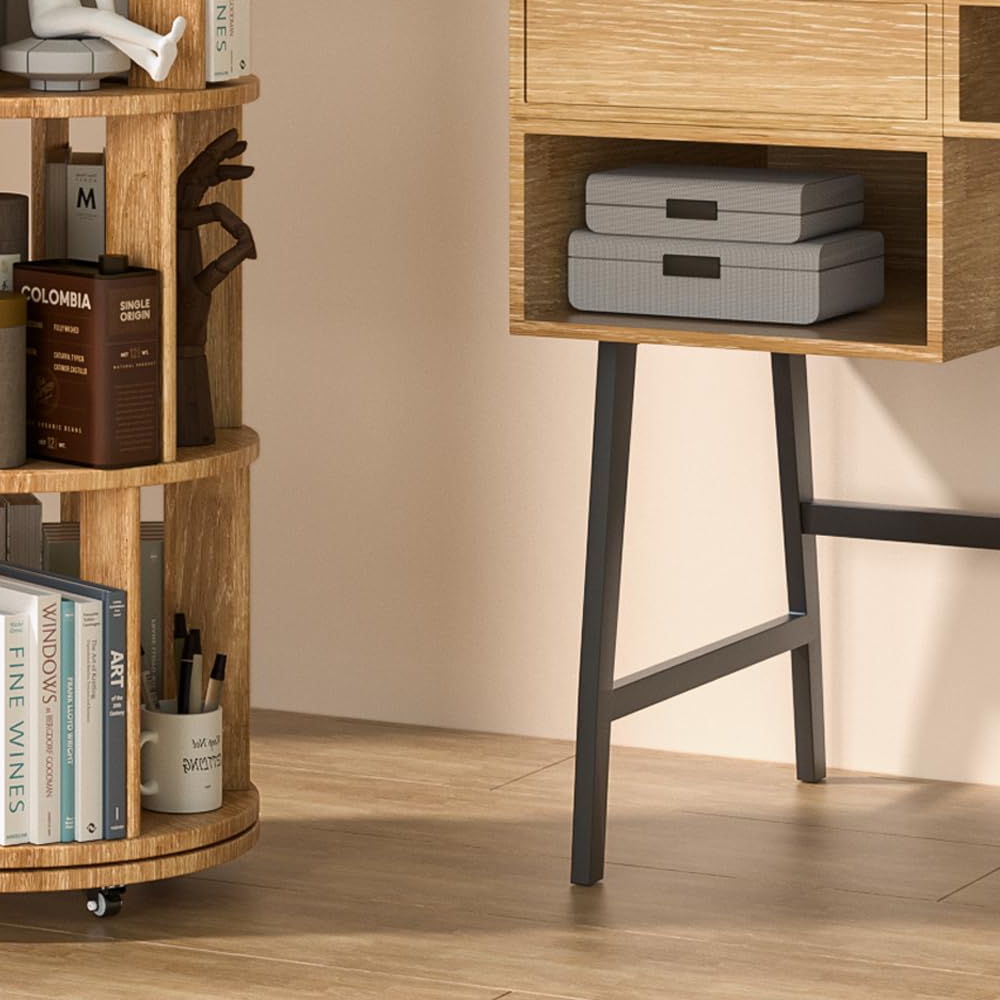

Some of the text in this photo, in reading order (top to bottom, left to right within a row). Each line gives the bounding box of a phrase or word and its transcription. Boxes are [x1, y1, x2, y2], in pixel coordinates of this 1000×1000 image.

[76, 187, 97, 210] M
[21, 285, 92, 311] COLOMBIA
[120, 299, 151, 312] SINGLE
[120, 310, 151, 322] ORIGIN
[42, 602, 58, 704] WINDOWS
[110, 650, 125, 689] ART
[8, 646, 25, 709] FINE
[8, 720, 25, 813] WINES
[45, 755, 53, 798] GOODMAN
